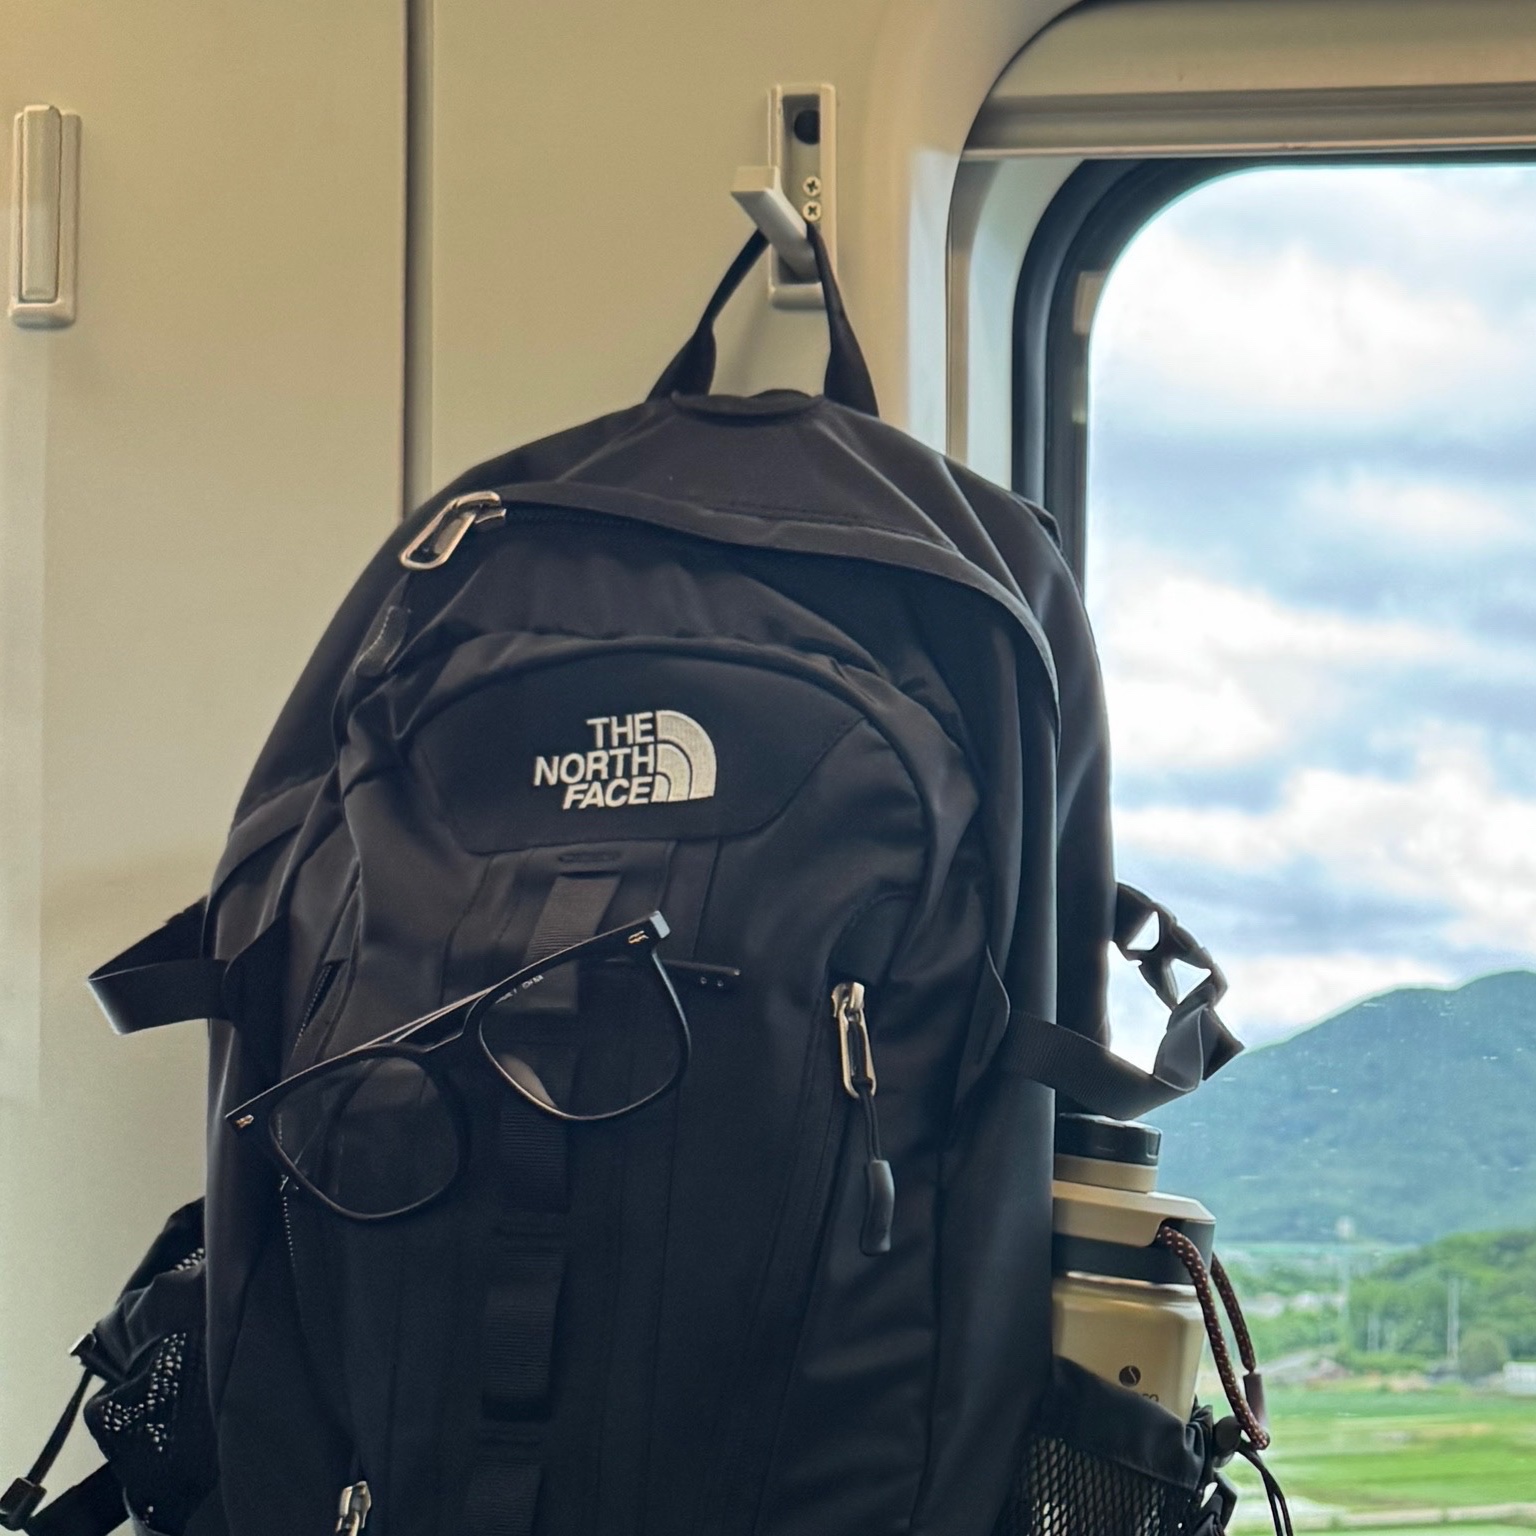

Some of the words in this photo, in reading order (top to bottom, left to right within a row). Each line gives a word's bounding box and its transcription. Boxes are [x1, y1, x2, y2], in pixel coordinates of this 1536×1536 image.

[586, 711, 654, 749] THE
[533, 744, 655, 787] NORTH
[562, 775, 653, 810] FACE
